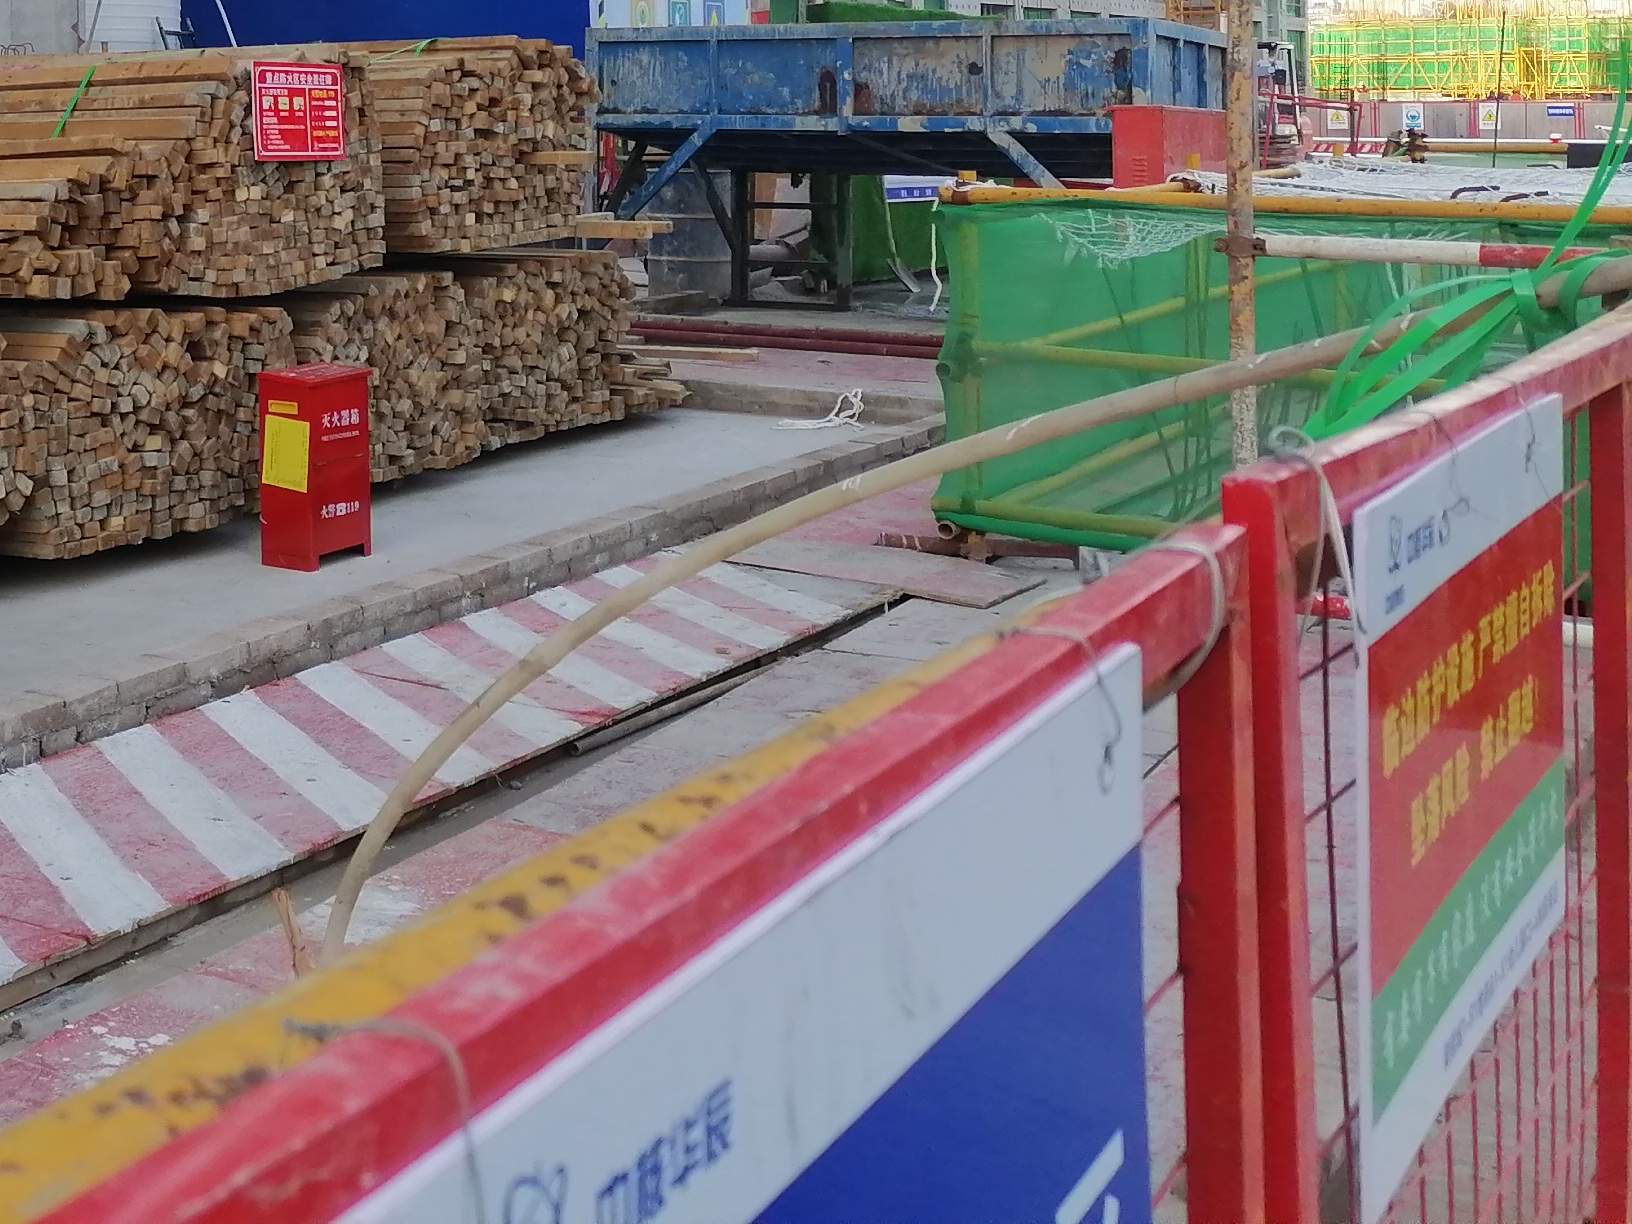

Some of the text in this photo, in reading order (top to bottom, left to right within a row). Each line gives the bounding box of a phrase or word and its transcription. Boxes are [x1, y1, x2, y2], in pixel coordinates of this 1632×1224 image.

[321, 408, 360, 429] 灭火器箱
[348, 501, 359, 513] 119
